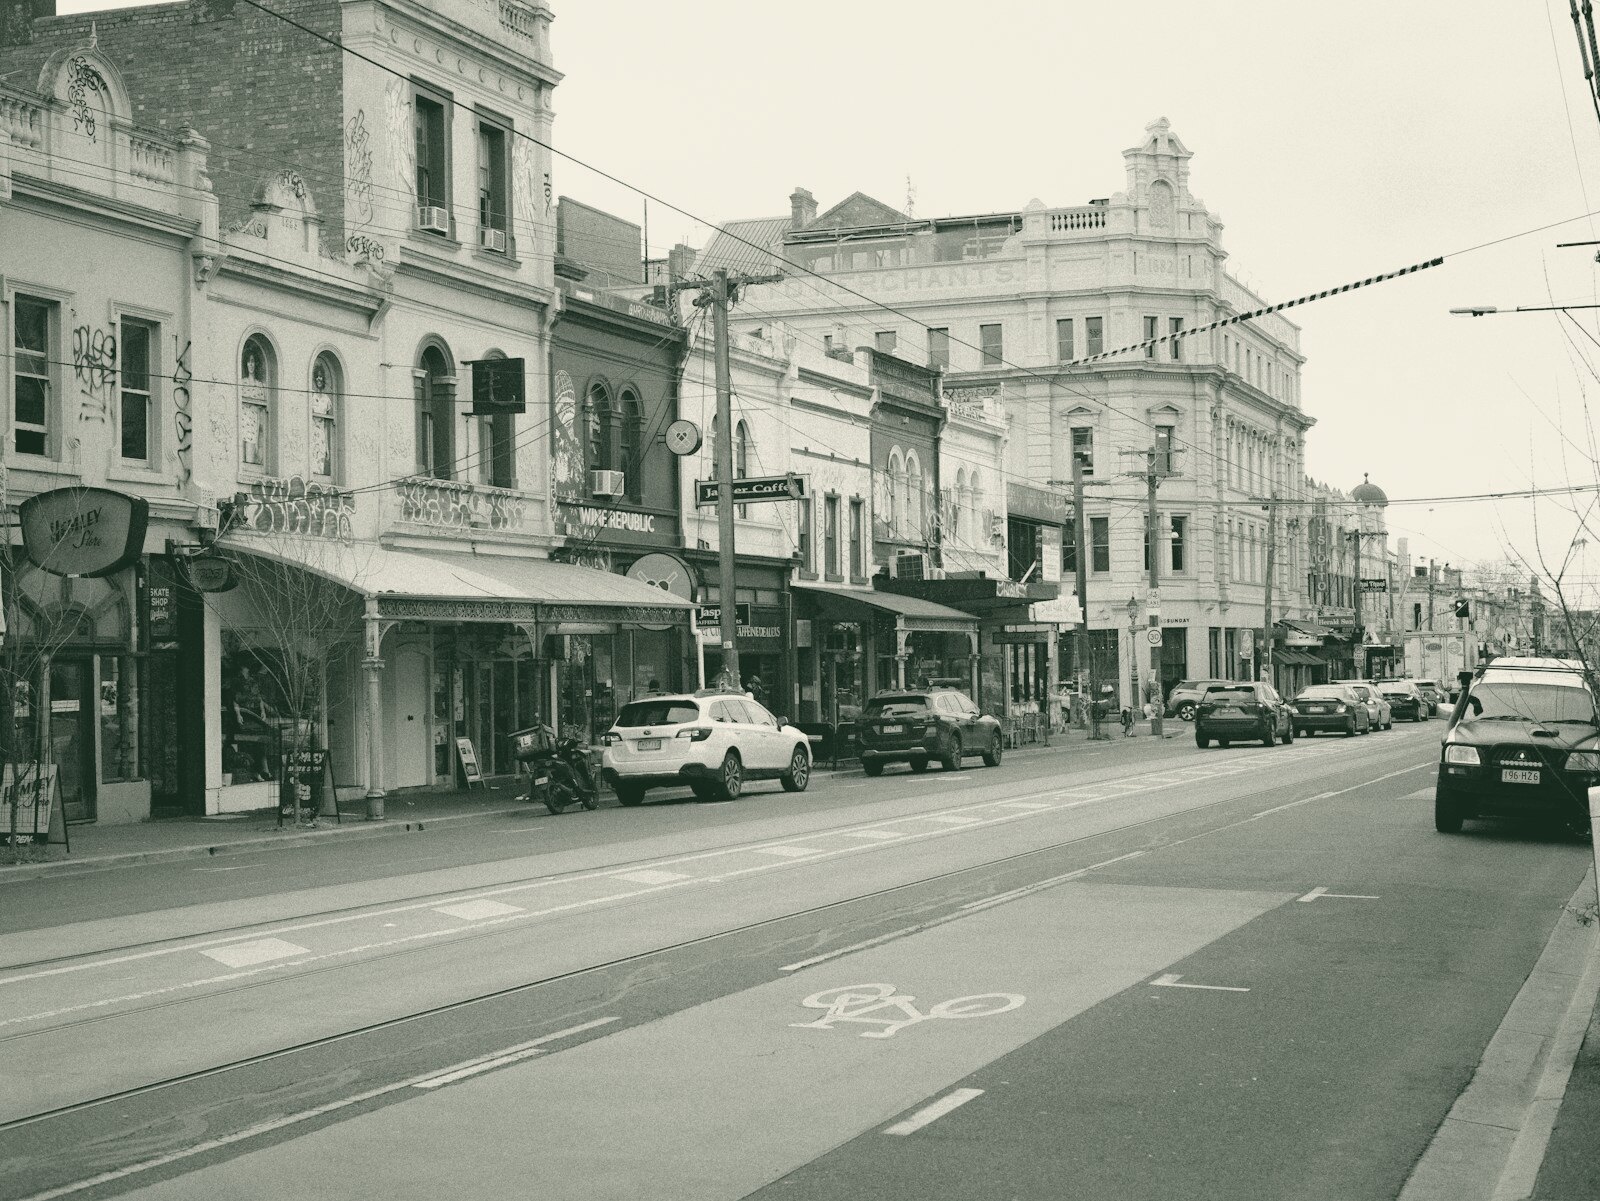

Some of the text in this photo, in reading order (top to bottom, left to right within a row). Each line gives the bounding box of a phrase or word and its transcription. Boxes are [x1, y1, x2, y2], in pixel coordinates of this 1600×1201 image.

[705, 481, 798, 498] Jaer Coffe
[580, 507, 655, 532] WINE REPUBLIC
[150, 588, 169, 597] SKATE
[151, 598, 168, 606] SHOP
[1150, 633, 1160, 641] 30
